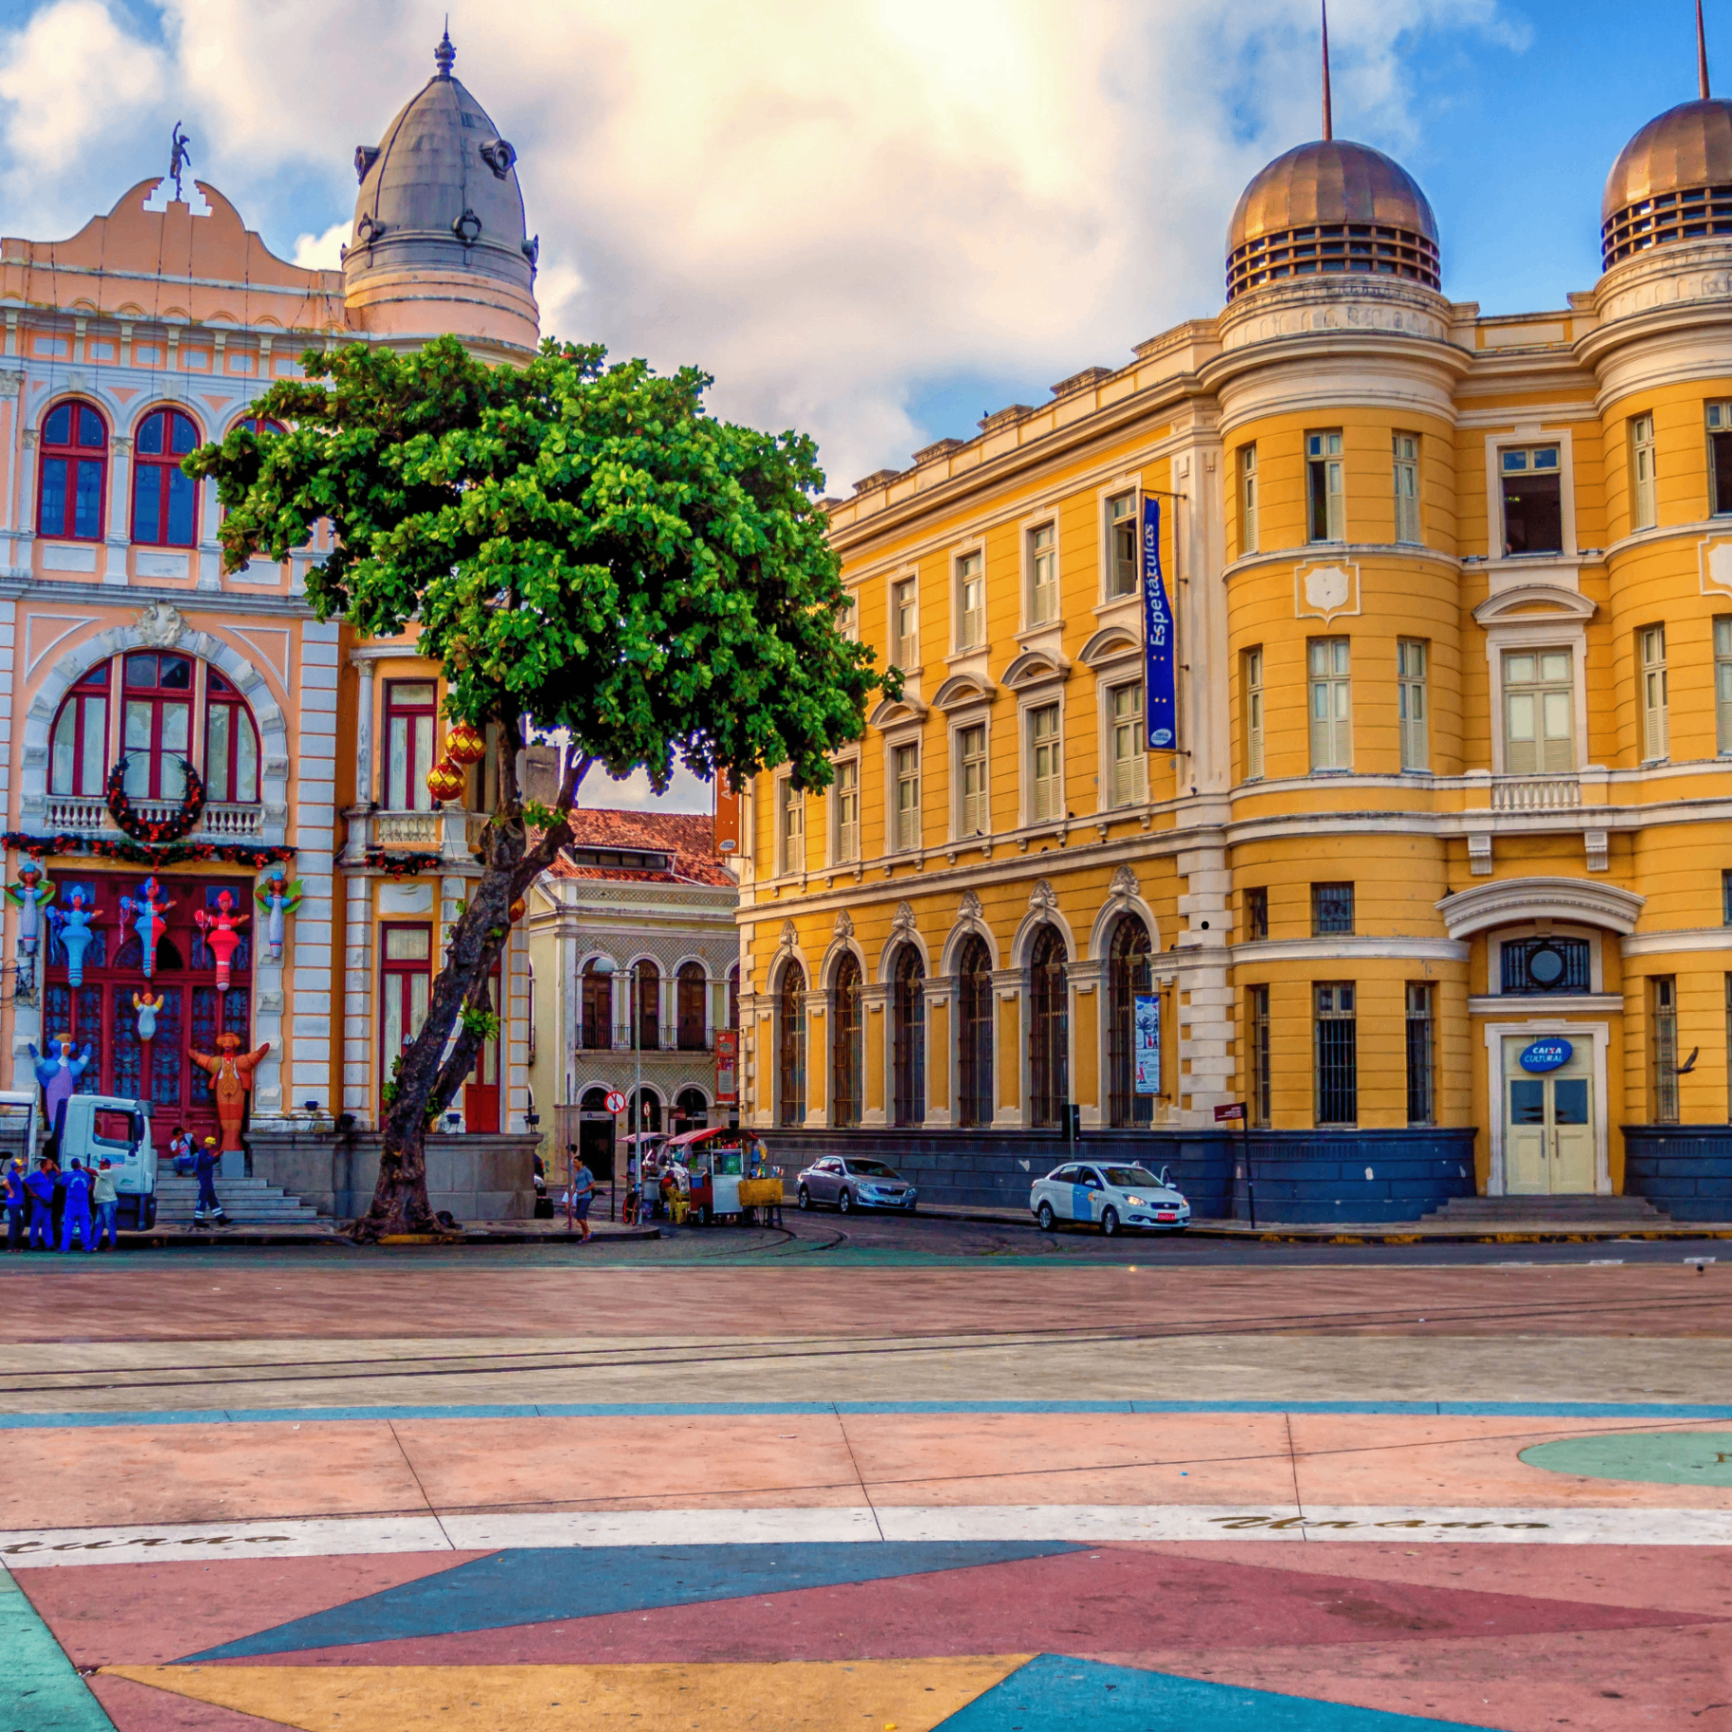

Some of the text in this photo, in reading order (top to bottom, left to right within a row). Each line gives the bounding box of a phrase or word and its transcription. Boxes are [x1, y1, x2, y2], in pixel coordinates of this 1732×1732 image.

[1144, 523, 1168, 646] Espetáculos
[1524, 1055, 1562, 1063] CULTURAL
[1208, 1516, 1552, 1530] Urano
